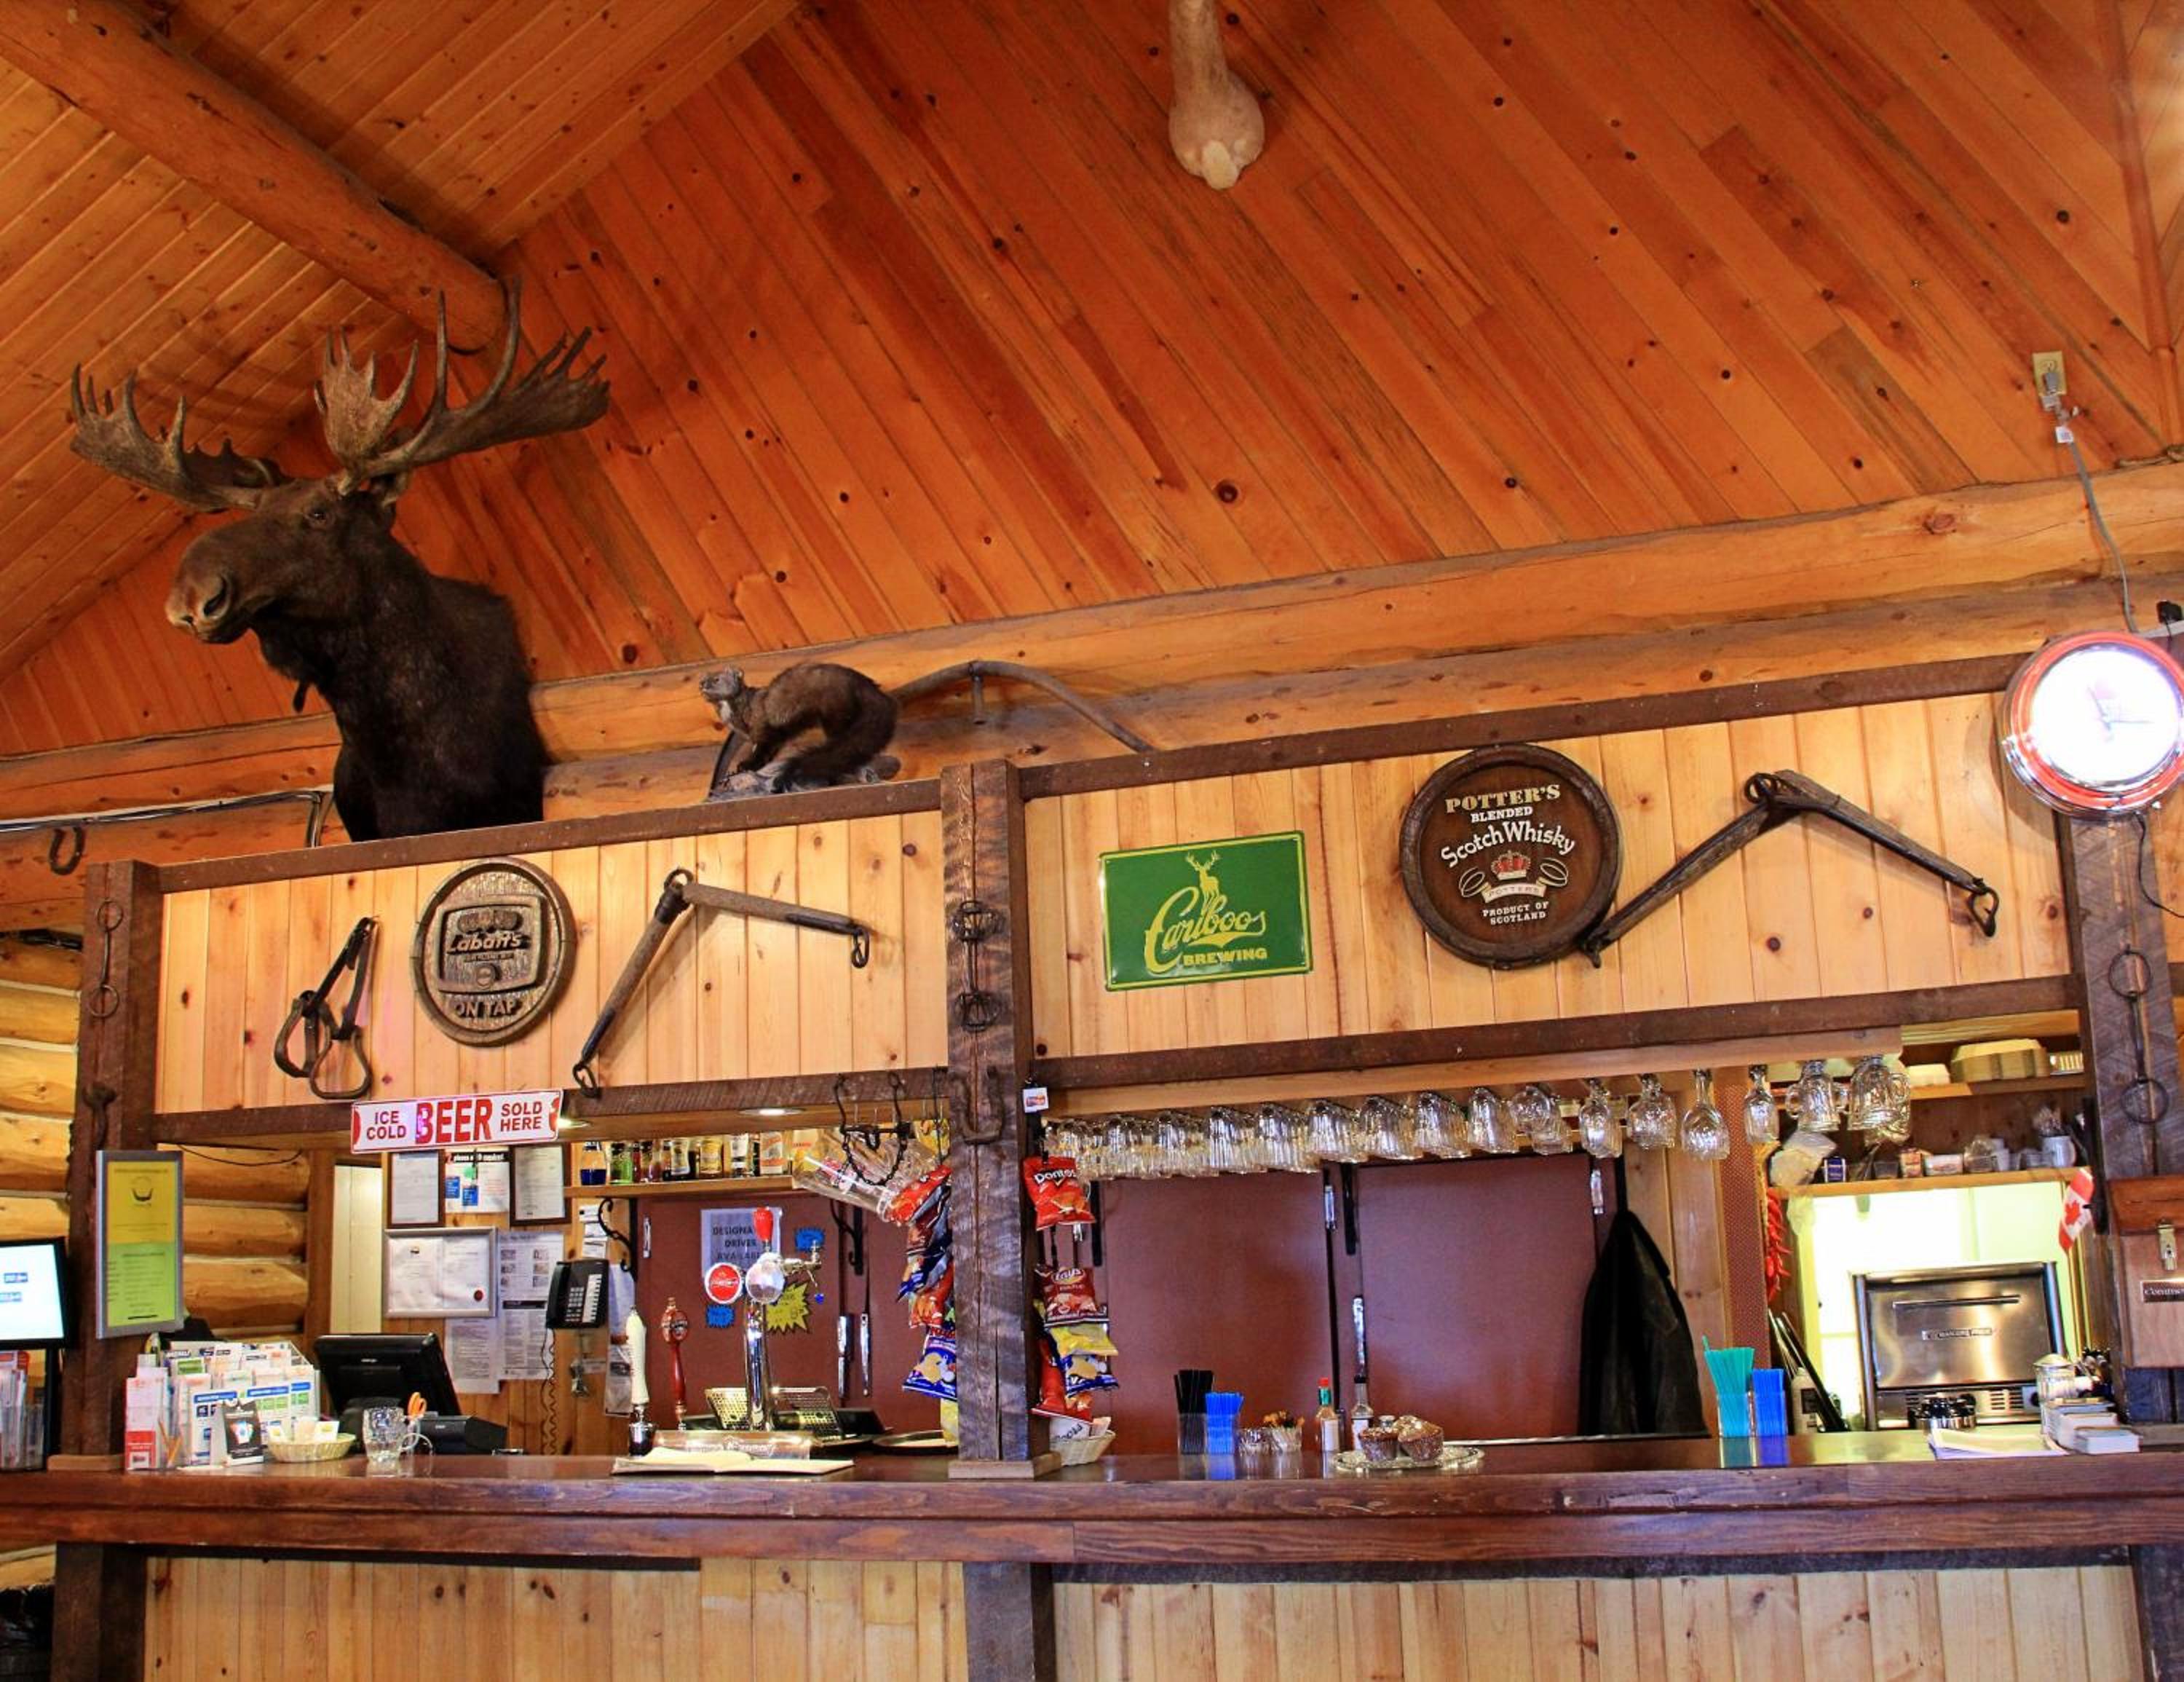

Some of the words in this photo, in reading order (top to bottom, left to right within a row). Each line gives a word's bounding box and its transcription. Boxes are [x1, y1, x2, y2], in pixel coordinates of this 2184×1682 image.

[1445, 784, 1561, 813] POTTER'S
[1471, 806, 1533, 824] BLENDED
[1441, 824, 1505, 868] Scotch
[1503, 820, 1575, 856] Whisky
[1482, 904, 1530, 917] PRODUCT
[1535, 901, 1549, 909] OF
[1490, 911, 1546, 925] SCOTLAND
[1182, 947, 1267, 966] BREWING
[482, 998, 517, 1017] TAP
[374, 1111, 400, 1124] ICE
[501, 1101, 542, 1117] SOLD
[415, 1098, 493, 1145] BEER
[500, 1116, 542, 1132] HERE
[366, 1125, 407, 1140] COLD
